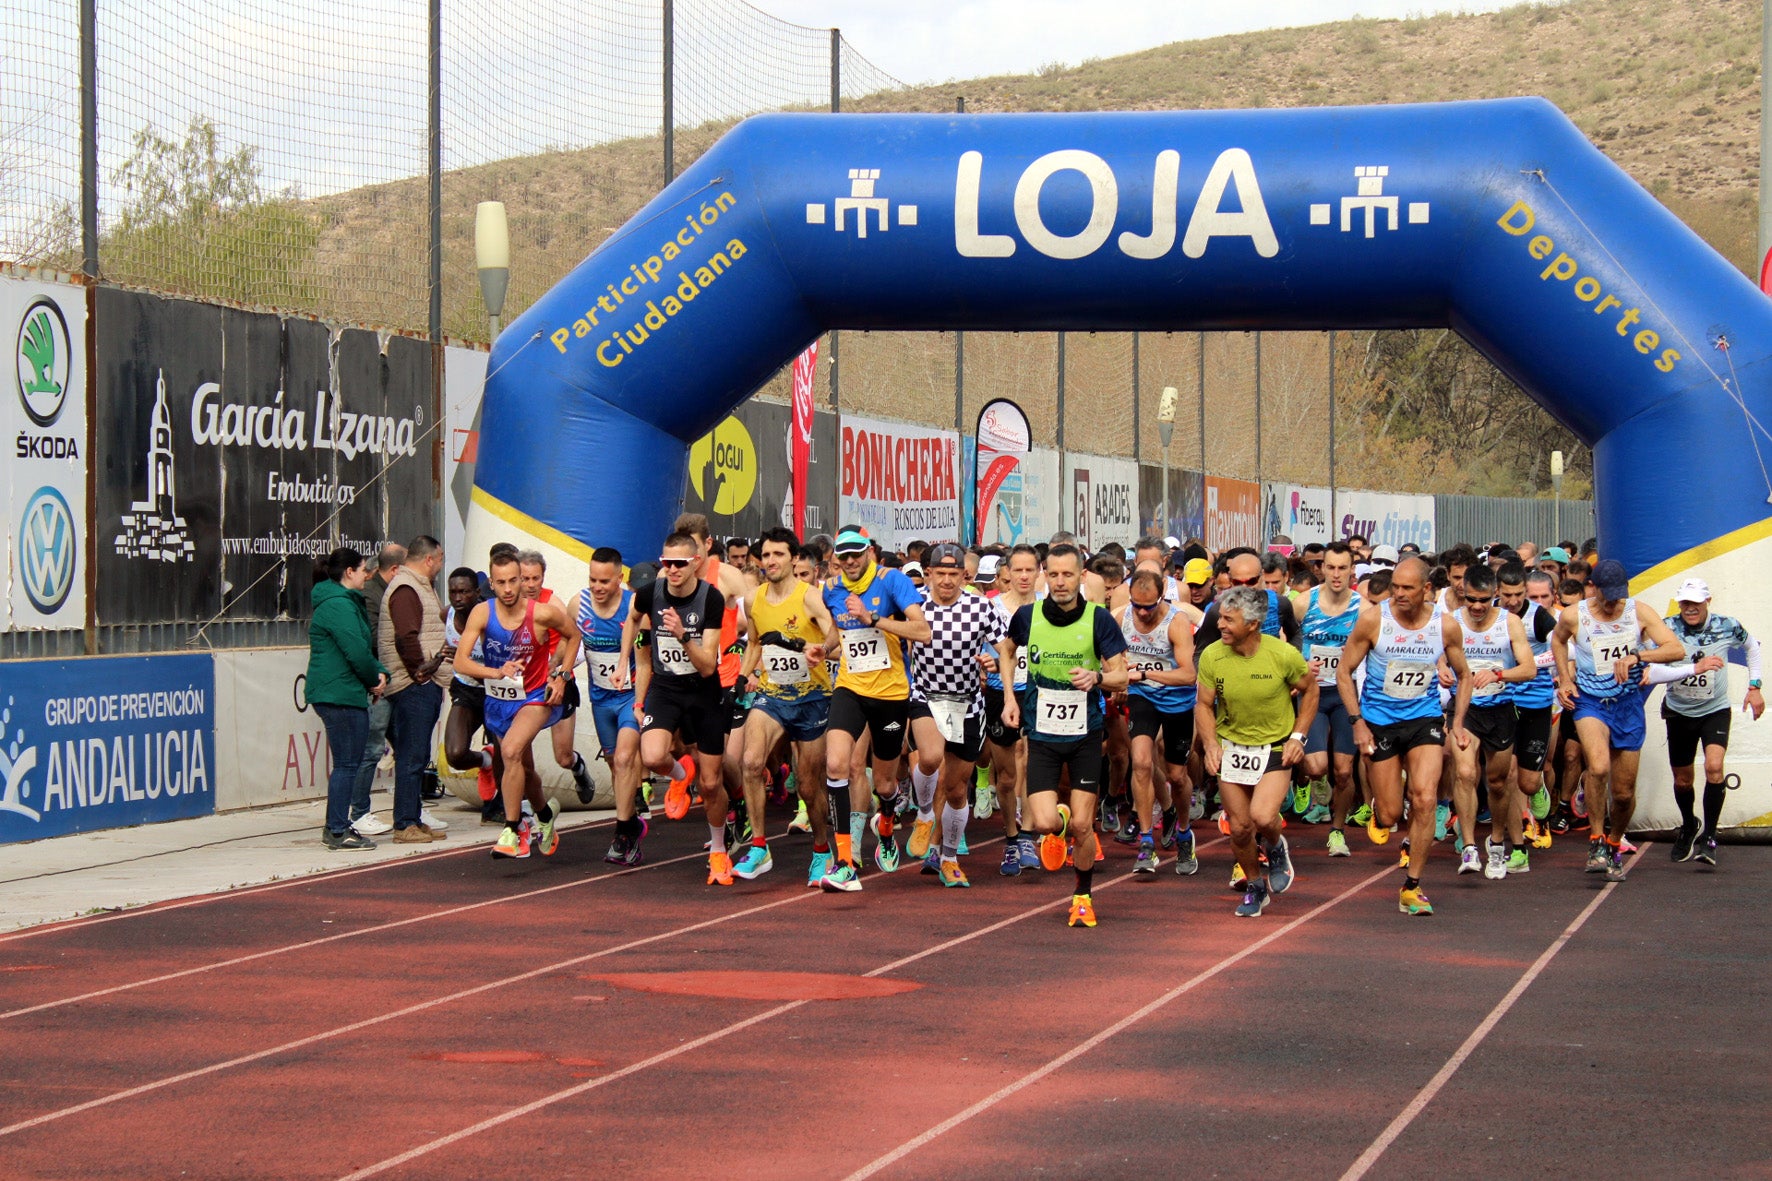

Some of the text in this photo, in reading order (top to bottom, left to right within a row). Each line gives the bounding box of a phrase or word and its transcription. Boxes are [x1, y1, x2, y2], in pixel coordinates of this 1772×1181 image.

[954, 148, 1280, 261] LOJA
[550, 191, 737, 355] Participación
[1496, 200, 1682, 373] Deportes
[596, 238, 748, 368] Ciudadana
[191, 382, 417, 461] García Lzana
[16, 430, 79, 460] ŠKODA
[841, 426, 956, 504] BONACHERA
[1095, 483, 1131, 525] ABADES
[894, 507, 924, 530] ROSCOS
[926, 507, 937, 529] DE
[938, 505, 956, 528] LOJA
[662, 649, 690, 664] 305
[848, 640, 878, 658] 597
[1043, 651, 1083, 659] Certificado
[1385, 645, 1434, 655] MARACENA
[1600, 644, 1630, 661] 741
[769, 658, 800, 671] 238
[1393, 672, 1425, 686] 472
[1680, 675, 1708, 688] 226
[490, 685, 517, 699] 579
[45, 683, 204, 727] GRUPO DE PREVENCIÓN
[1046, 704, 1079, 720] 737
[44, 728, 208, 813] ANDALUCIA
[1231, 754, 1261, 771] 320
